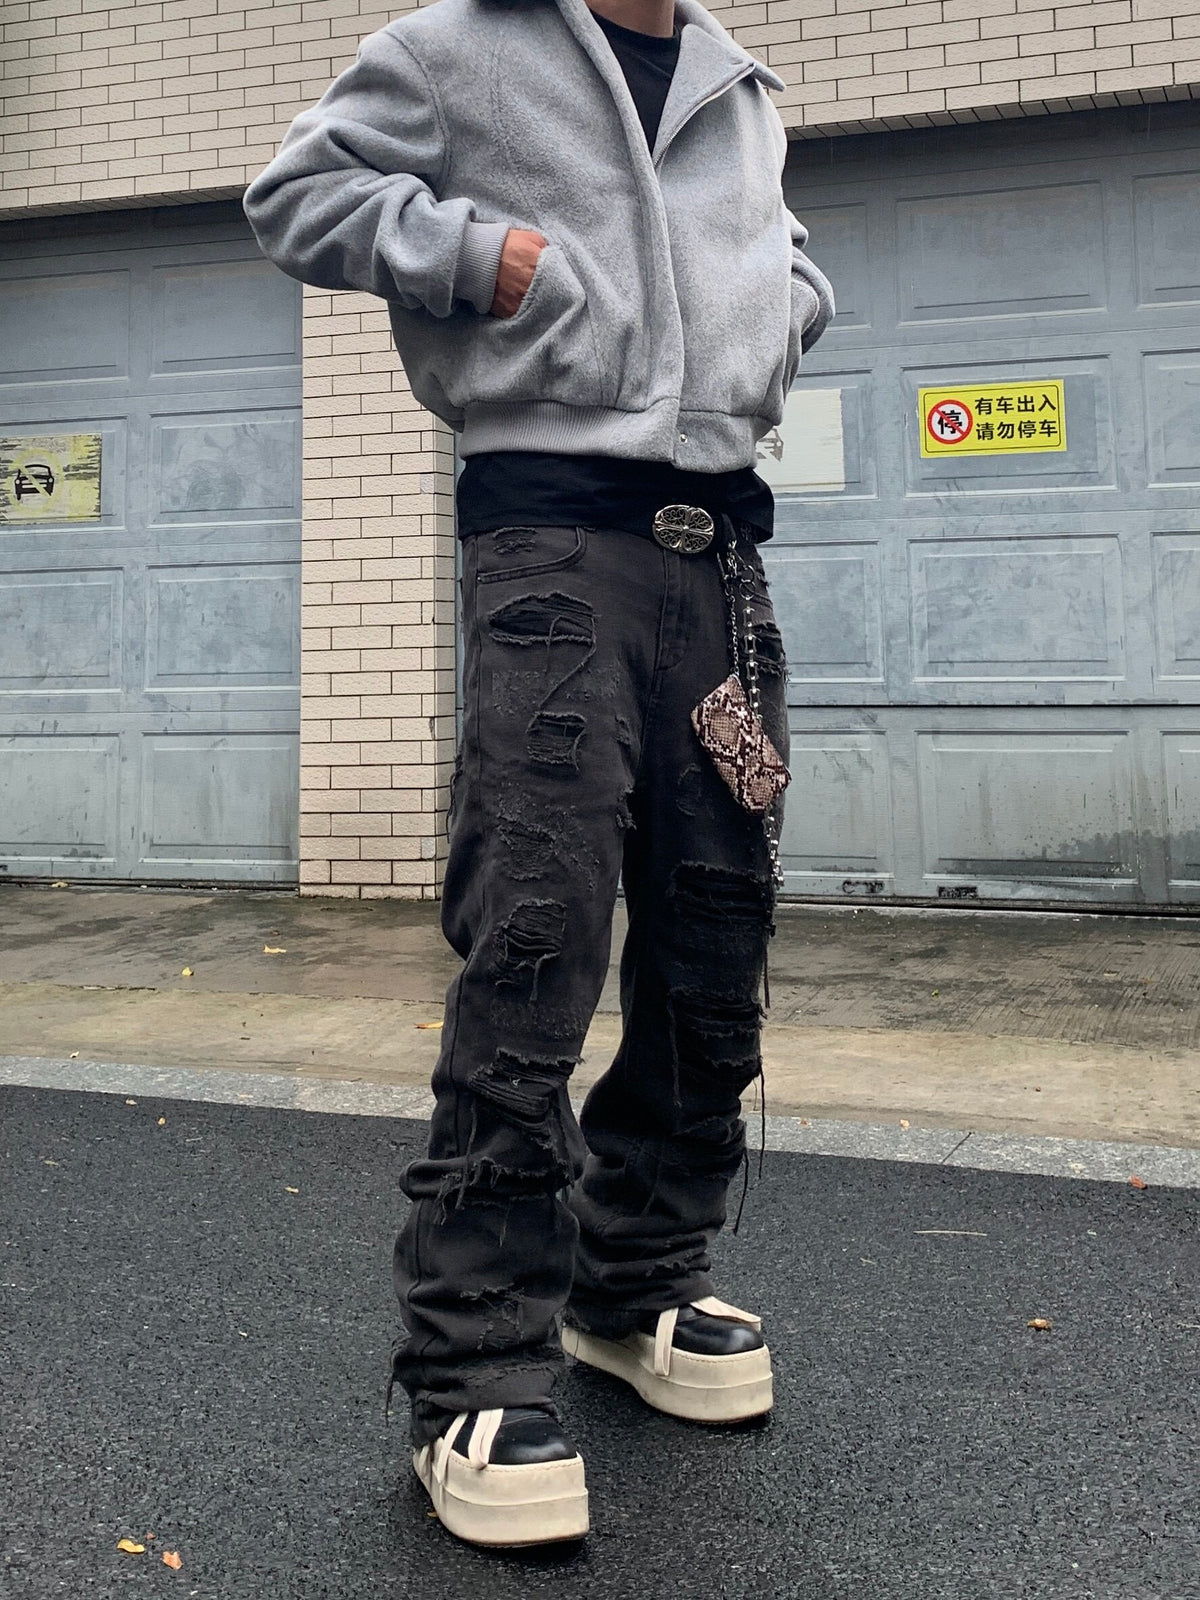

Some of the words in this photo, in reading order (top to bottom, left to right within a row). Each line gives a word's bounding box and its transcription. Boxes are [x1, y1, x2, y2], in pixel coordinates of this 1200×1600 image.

[974, 394, 1057, 415] 有车出入
[975, 419, 1058, 440] 请勿停车
